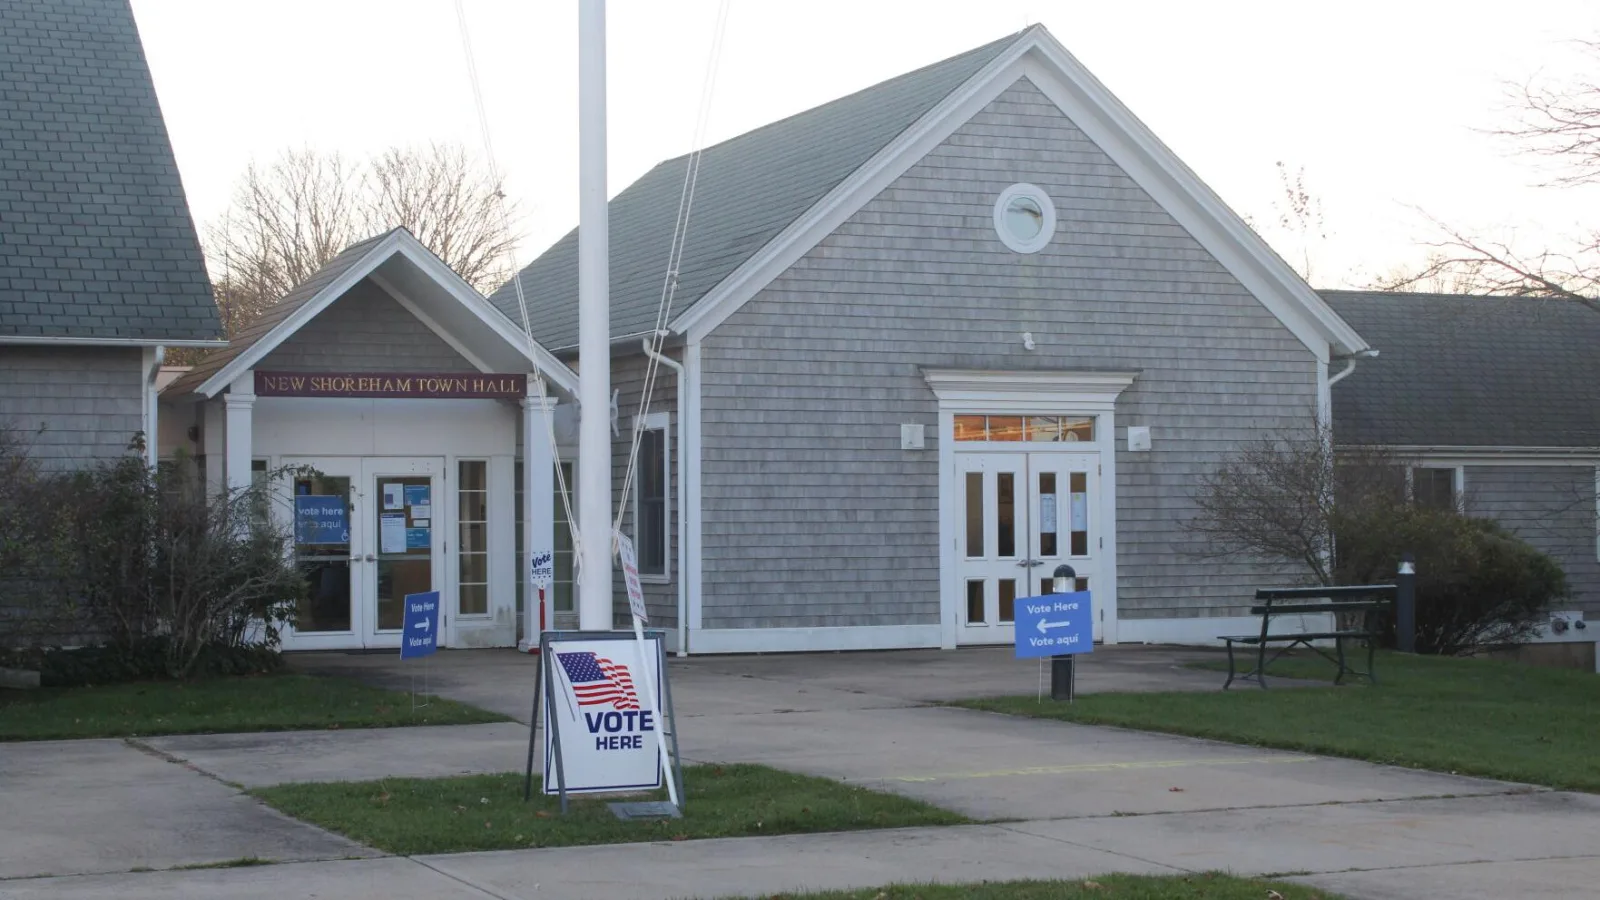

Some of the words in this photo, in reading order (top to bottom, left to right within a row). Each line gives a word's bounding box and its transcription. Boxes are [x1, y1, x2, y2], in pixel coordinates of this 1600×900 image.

[264, 377, 305, 391] NEW
[310, 377, 411, 392] SHOREHAM
[416, 379, 468, 393] TOWN
[473, 380, 520, 393] HALL
[298, 507, 320, 516] vote
[321, 507, 344, 516] here
[532, 553, 551, 568] Vote
[531, 567, 551, 576] HERE
[411, 603, 423, 613] Vote
[423, 602, 435, 611] Here
[1027, 605, 1051, 615] Vote
[1054, 602, 1079, 612] Here
[409, 636, 422, 647] Vote
[1029, 637, 1054, 647] Vote
[1056, 633, 1079, 646] aquí
[584, 710, 654, 733] VOTE
[595, 735, 642, 750] HERE
